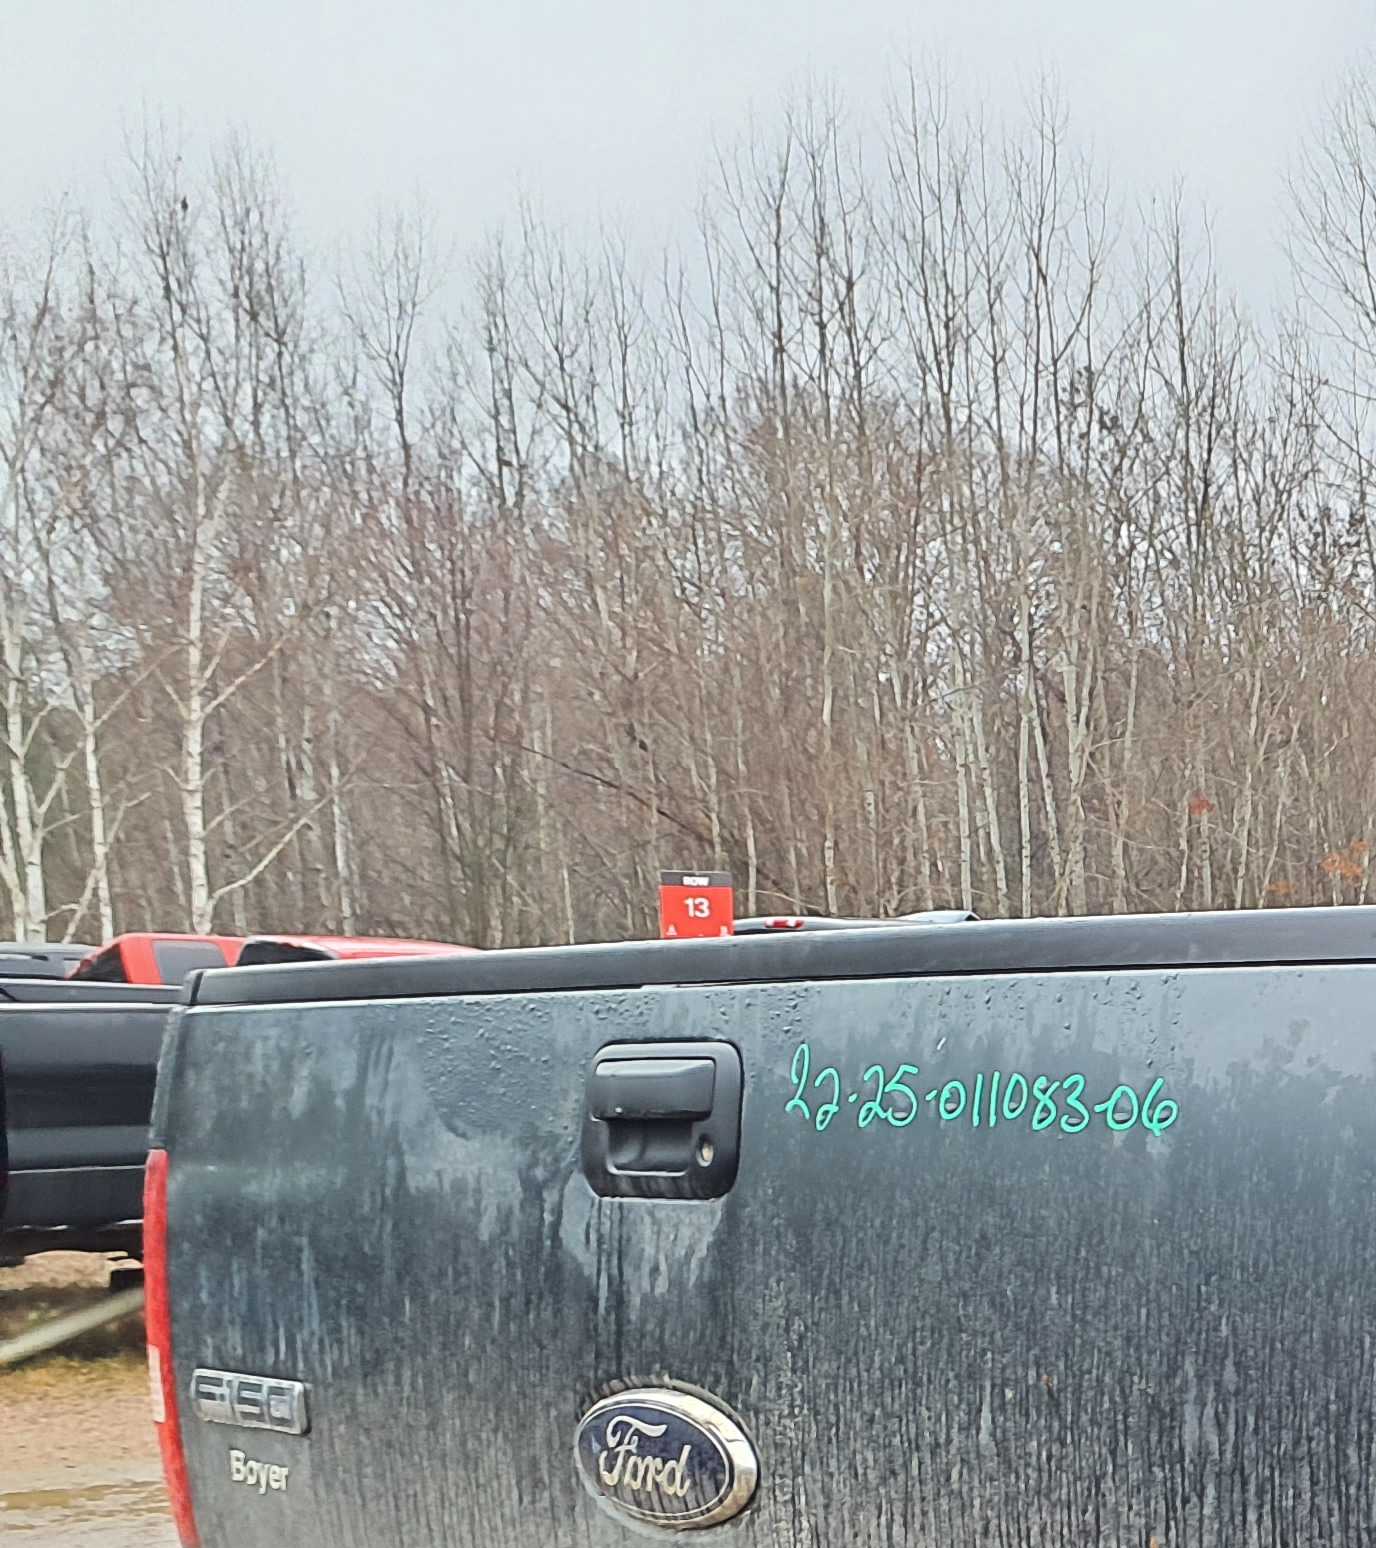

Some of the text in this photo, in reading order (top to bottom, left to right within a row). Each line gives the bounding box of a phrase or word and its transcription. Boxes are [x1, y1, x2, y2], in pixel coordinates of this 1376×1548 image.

[684, 897, 711, 918] 13
[229, 1450, 289, 1495] Boyer
[599, 1415, 692, 1497] Ford
